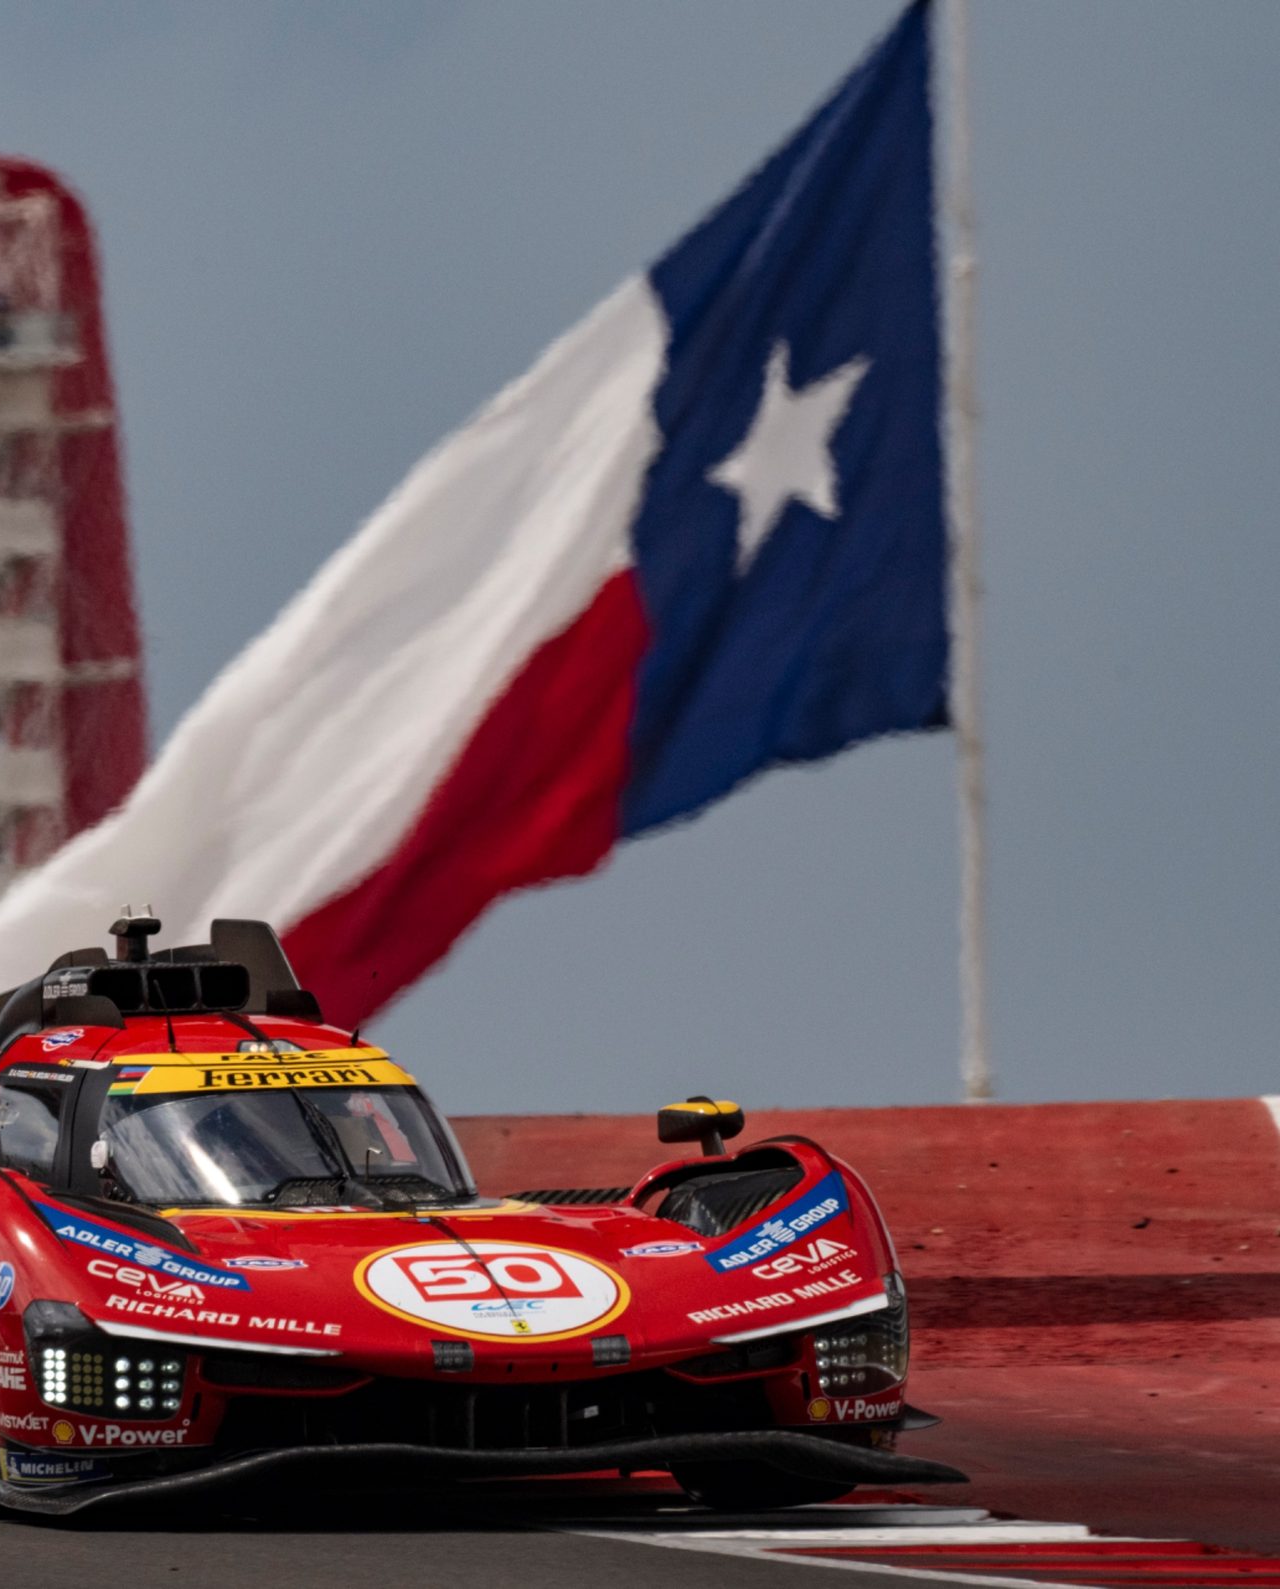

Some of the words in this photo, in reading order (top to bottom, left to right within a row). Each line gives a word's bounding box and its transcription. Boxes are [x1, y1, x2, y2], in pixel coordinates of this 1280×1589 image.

[198, 1064, 380, 1088] Ferrari
[720, 1239, 779, 1270] ADLER
[790, 1198, 840, 1232] GROUP
[56, 1225, 133, 1257] ADLER
[162, 1262, 239, 1288] GROUP
[808, 1249, 858, 1275] LOGISTICS
[409, 1257, 563, 1295] 50
[136, 1288, 204, 1305] LOGISTICS
[687, 1291, 796, 1324] RICHARD
[793, 1269, 862, 1300] MILLE
[106, 1295, 239, 1326] RICHARD
[248, 1317, 342, 1336] MILLE
[834, 1399, 901, 1420] V-Power
[79, 1423, 187, 1445] V-Power
[20, 1460, 94, 1475] MICHELIN
